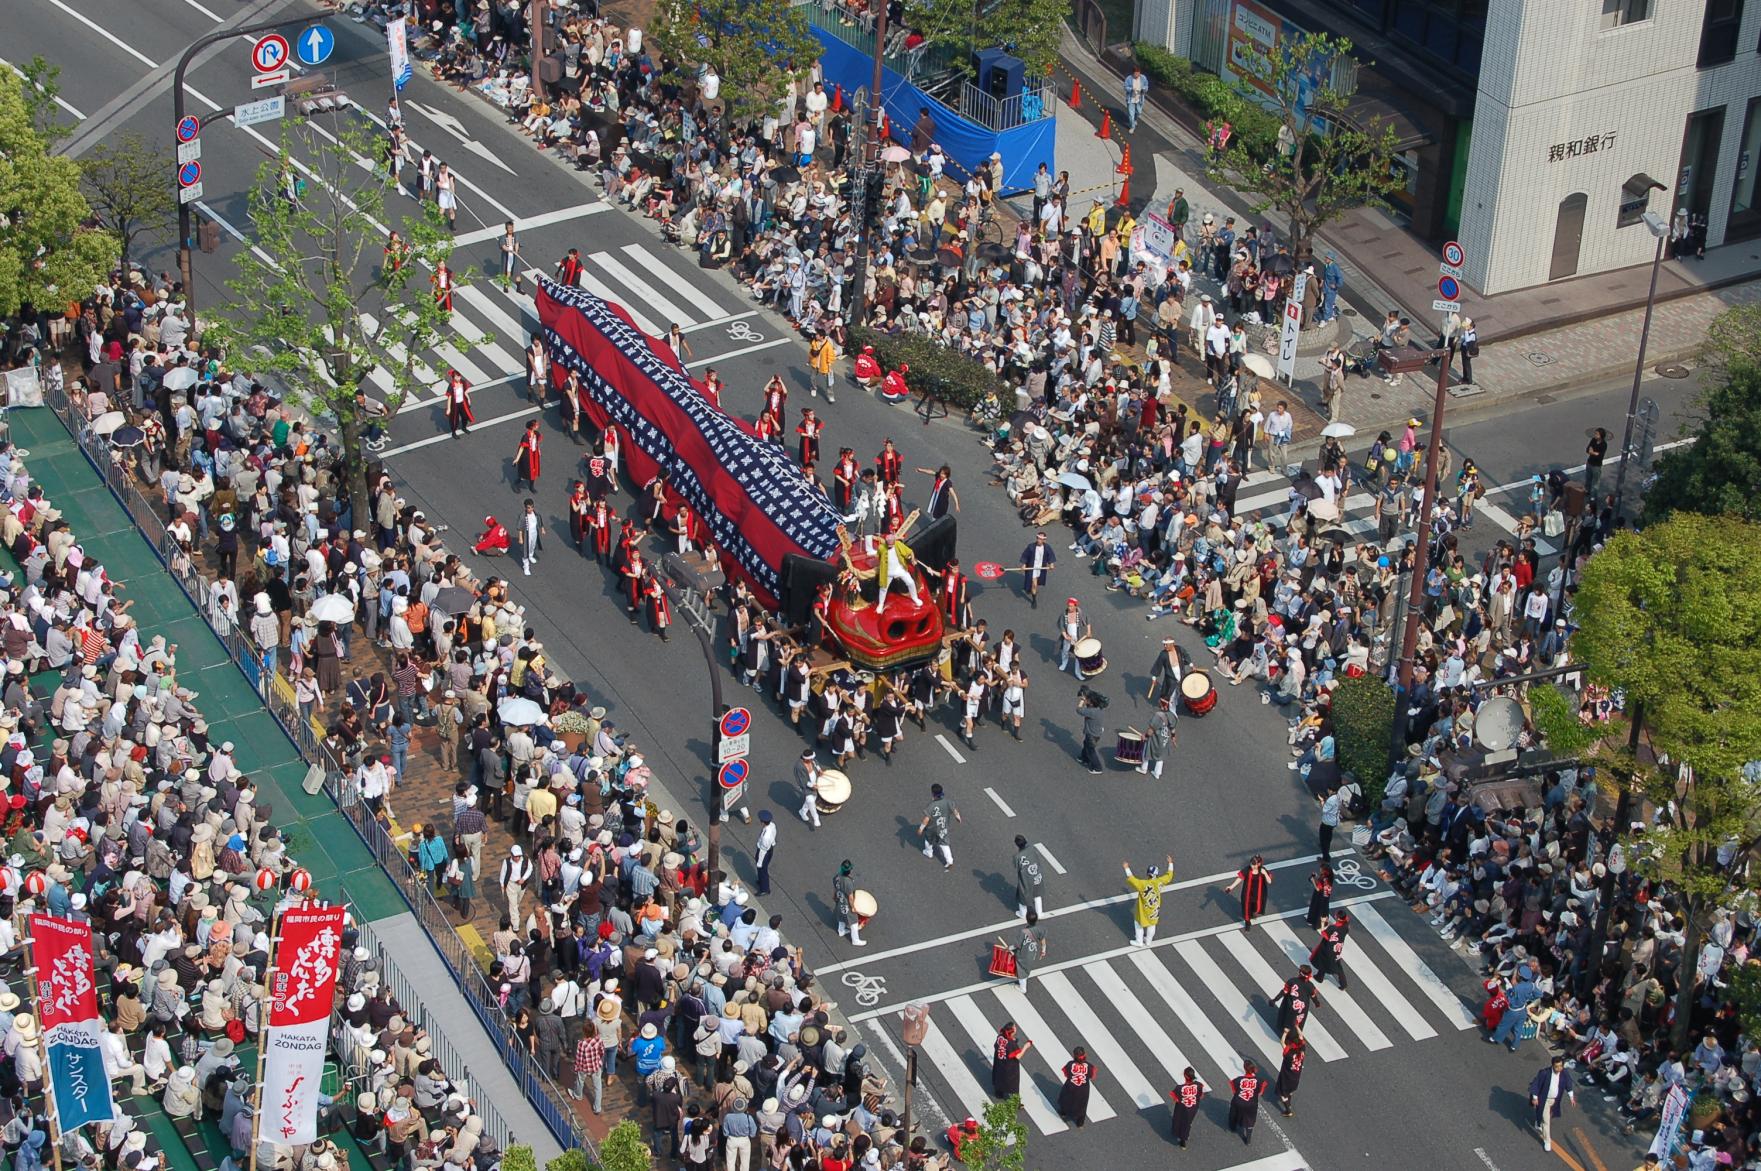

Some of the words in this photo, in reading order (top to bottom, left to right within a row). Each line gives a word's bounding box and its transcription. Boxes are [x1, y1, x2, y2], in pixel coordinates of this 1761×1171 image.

[1548, 130, 1617, 163] 親和銀行
[1447, 247, 1460, 261] 30
[1434, 301, 1459, 311] ここから
[1282, 322, 1295, 361] トイレ
[285, 913, 341, 924] 福岡市民の祭り
[56, 1025, 90, 1038] HAKATA
[280, 1032, 317, 1043] HAKATA
[274, 1039, 322, 1051] ZONDAG
[65, 1051, 89, 1113] サンスター
